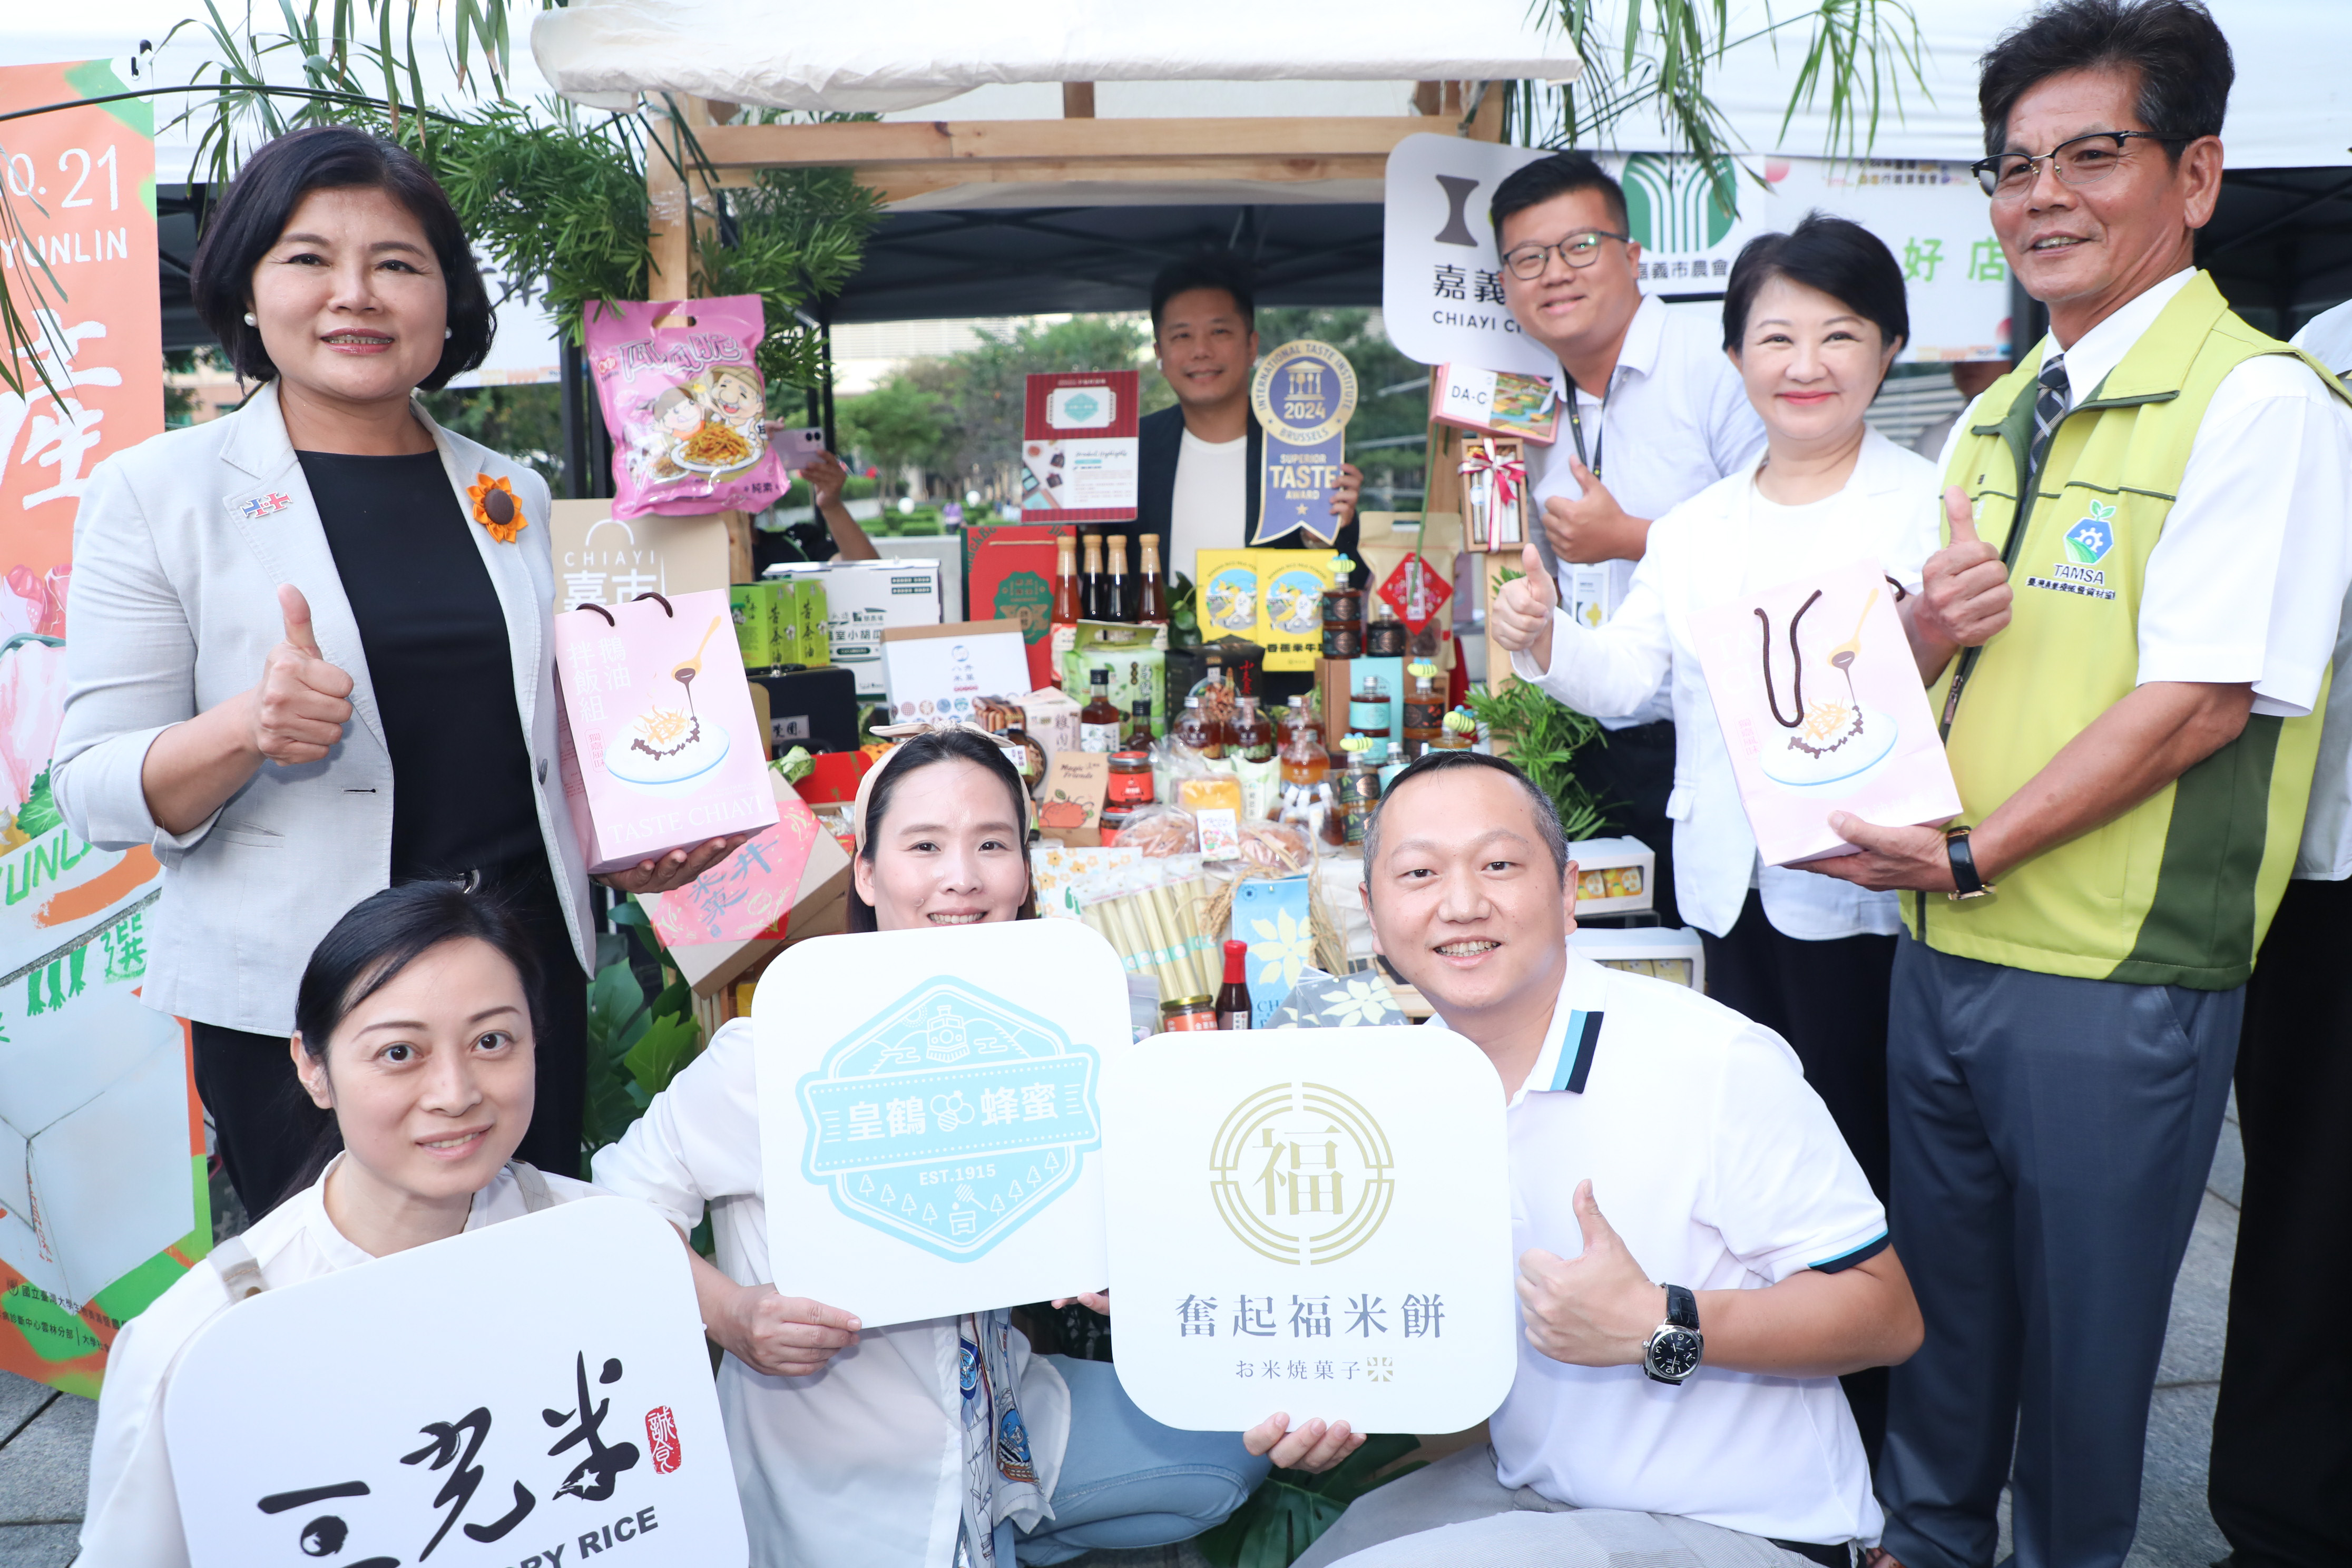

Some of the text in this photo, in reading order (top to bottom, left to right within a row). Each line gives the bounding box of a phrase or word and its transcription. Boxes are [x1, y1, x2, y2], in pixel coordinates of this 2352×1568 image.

[0, 227, 128, 269] YUNLIN
[1433, 310, 1496, 331] CHIAYI
[1258, 344, 1353, 411] INTERNATIONAL TASTE INSTITUTE
[1283, 402, 1326, 419] 2024
[1279, 428, 1329, 442] BRUSSELS
[1280, 454, 1327, 464] SUPERIOR
[751, 482, 773, 493] 純素
[1269, 465, 1338, 489] TASTE
[1285, 490, 1319, 500] AWARD
[564, 551, 654, 566] CHIAYI
[2054, 564, 2104, 585] TAMSA
[597, 635, 631, 691] 鵝油
[566, 640, 609, 723] 拌飯組
[607, 795, 765, 844] TASTE CHIAYI
[847, 1081, 1060, 1143] 皇鶴 蜂蜜
[918, 1163, 997, 1187] EST.1915
[1252, 1124, 1345, 1216] 福
[1175, 1293, 1446, 1339] 奮起福米餅
[1234, 1359, 1361, 1381] お米焼菓子
[577, 1505, 659, 1560] RICE
